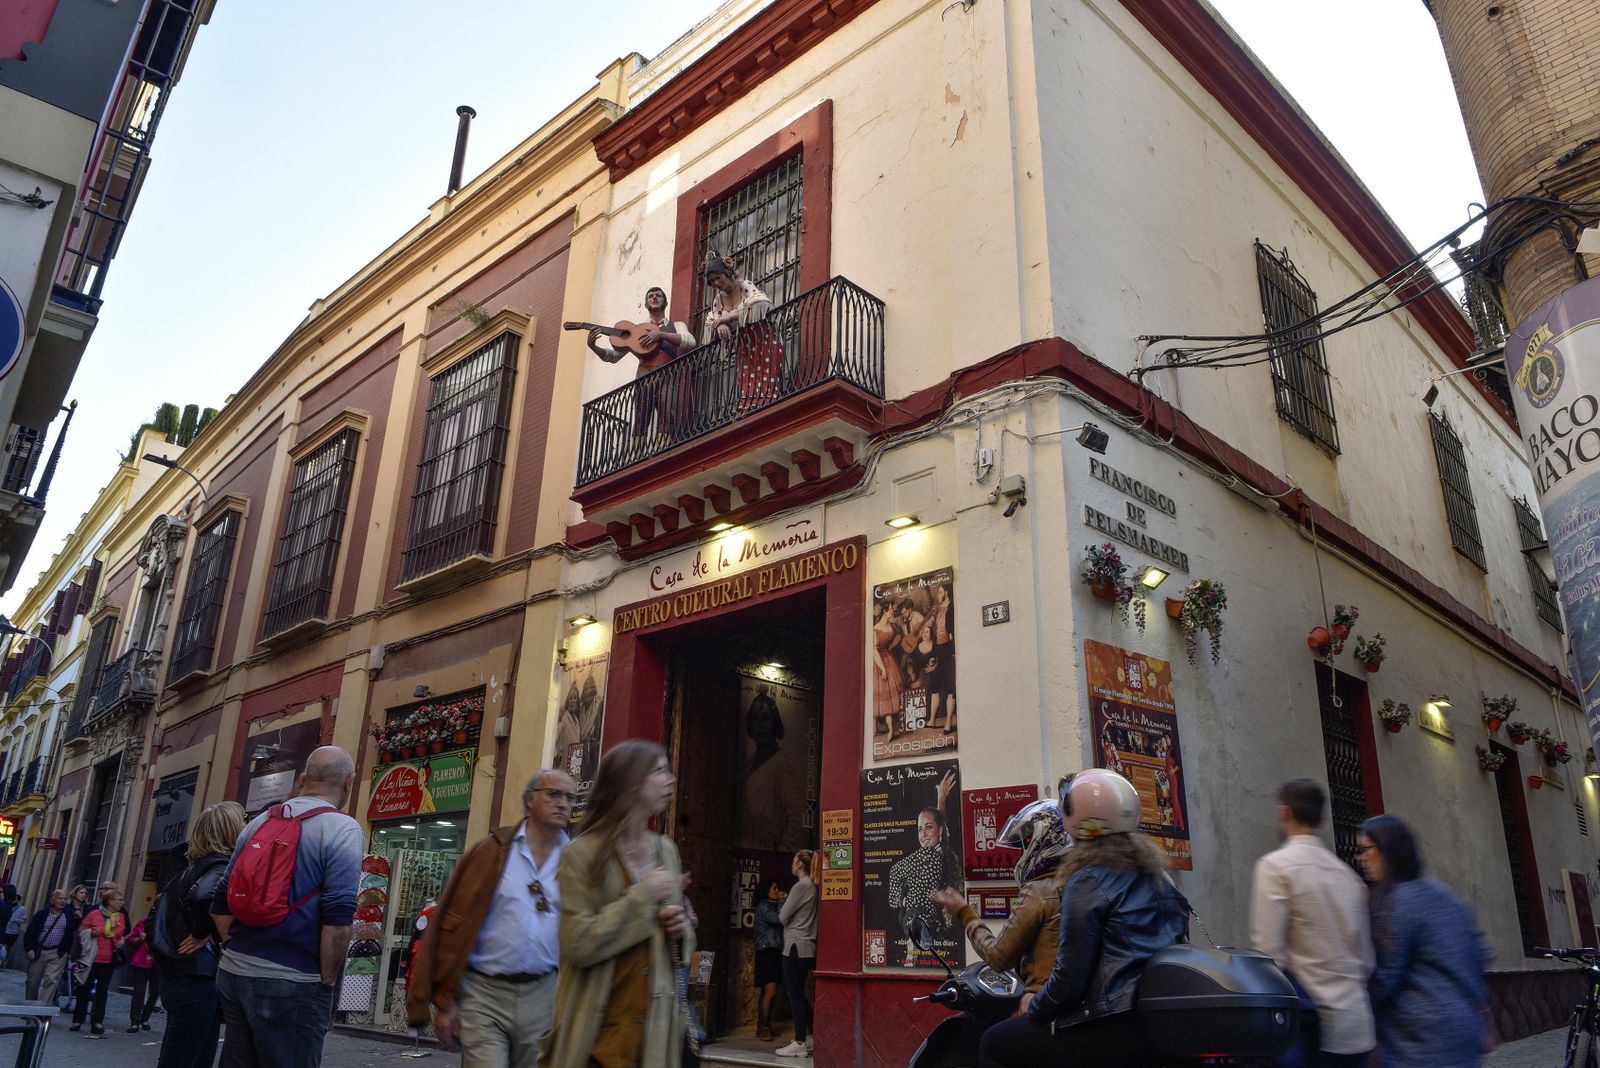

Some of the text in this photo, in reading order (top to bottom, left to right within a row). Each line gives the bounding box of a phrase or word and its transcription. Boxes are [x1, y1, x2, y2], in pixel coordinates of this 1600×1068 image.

[1527, 333, 1541, 358] 1977
[1529, 394, 1598, 463] BACO
[1089, 457, 1176, 516] FRANCISCO
[1126, 502, 1146, 526] DE
[1084, 505, 1189, 573] PELSMAEKER
[650, 522, 819, 591] Casa de la Memoria
[614, 543, 858, 634] CENTRO CULTURAL FLAMENCO
[874, 586, 891, 599] Casa
[991, 607, 999, 619] 6
[906, 698, 926, 708] FLA
[906, 718, 926, 730] CO
[1102, 701, 1121, 721] Casa
[1122, 708, 1131, 722] de
[1141, 713, 1172, 731] Memoria
[874, 734, 955, 756] Exposición
[433, 766, 465, 782] FLAMENCO
[867, 771, 883, 784] Casa
[436, 782, 469, 798] SOUVENIRS
[975, 817, 995, 827] FLA
[827, 827, 848, 836] 19:30
[976, 828, 995, 839] MEN
[976, 839, 996, 850] CO
[826, 887, 848, 896] 21:00
